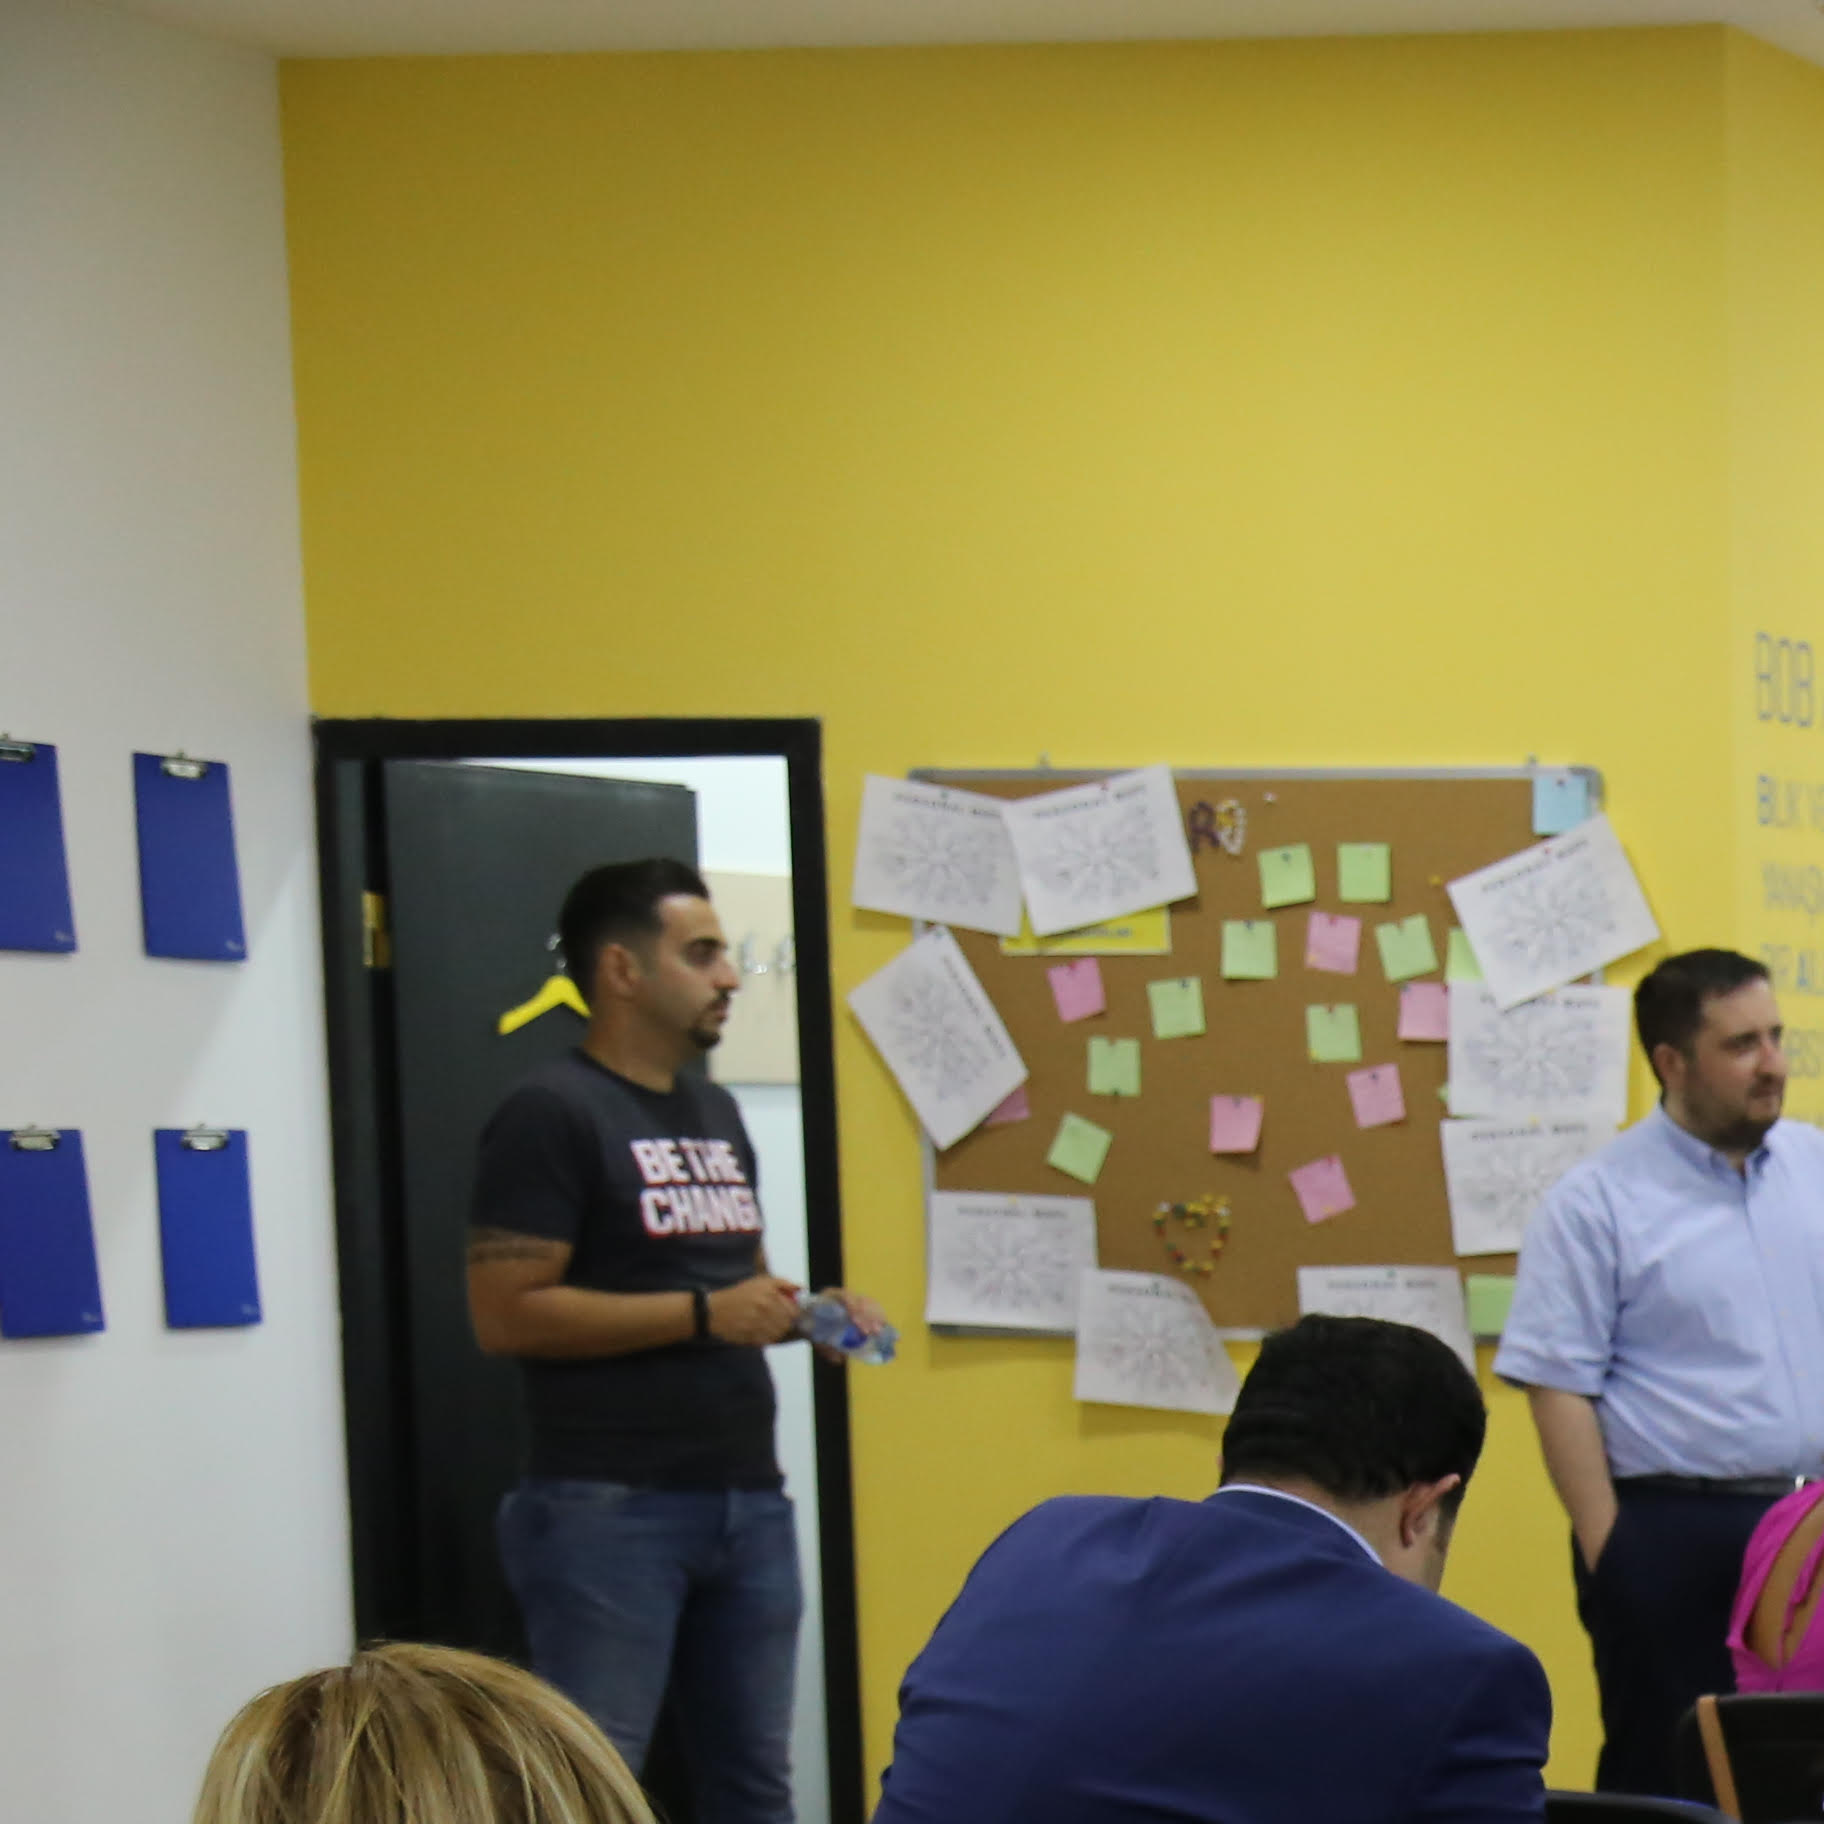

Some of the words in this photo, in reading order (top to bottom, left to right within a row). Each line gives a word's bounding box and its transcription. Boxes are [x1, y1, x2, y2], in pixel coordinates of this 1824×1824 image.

[630, 1137, 691, 1186] BE
[678, 1137, 747, 1185] THE
[640, 1184, 763, 1238] CHANG
